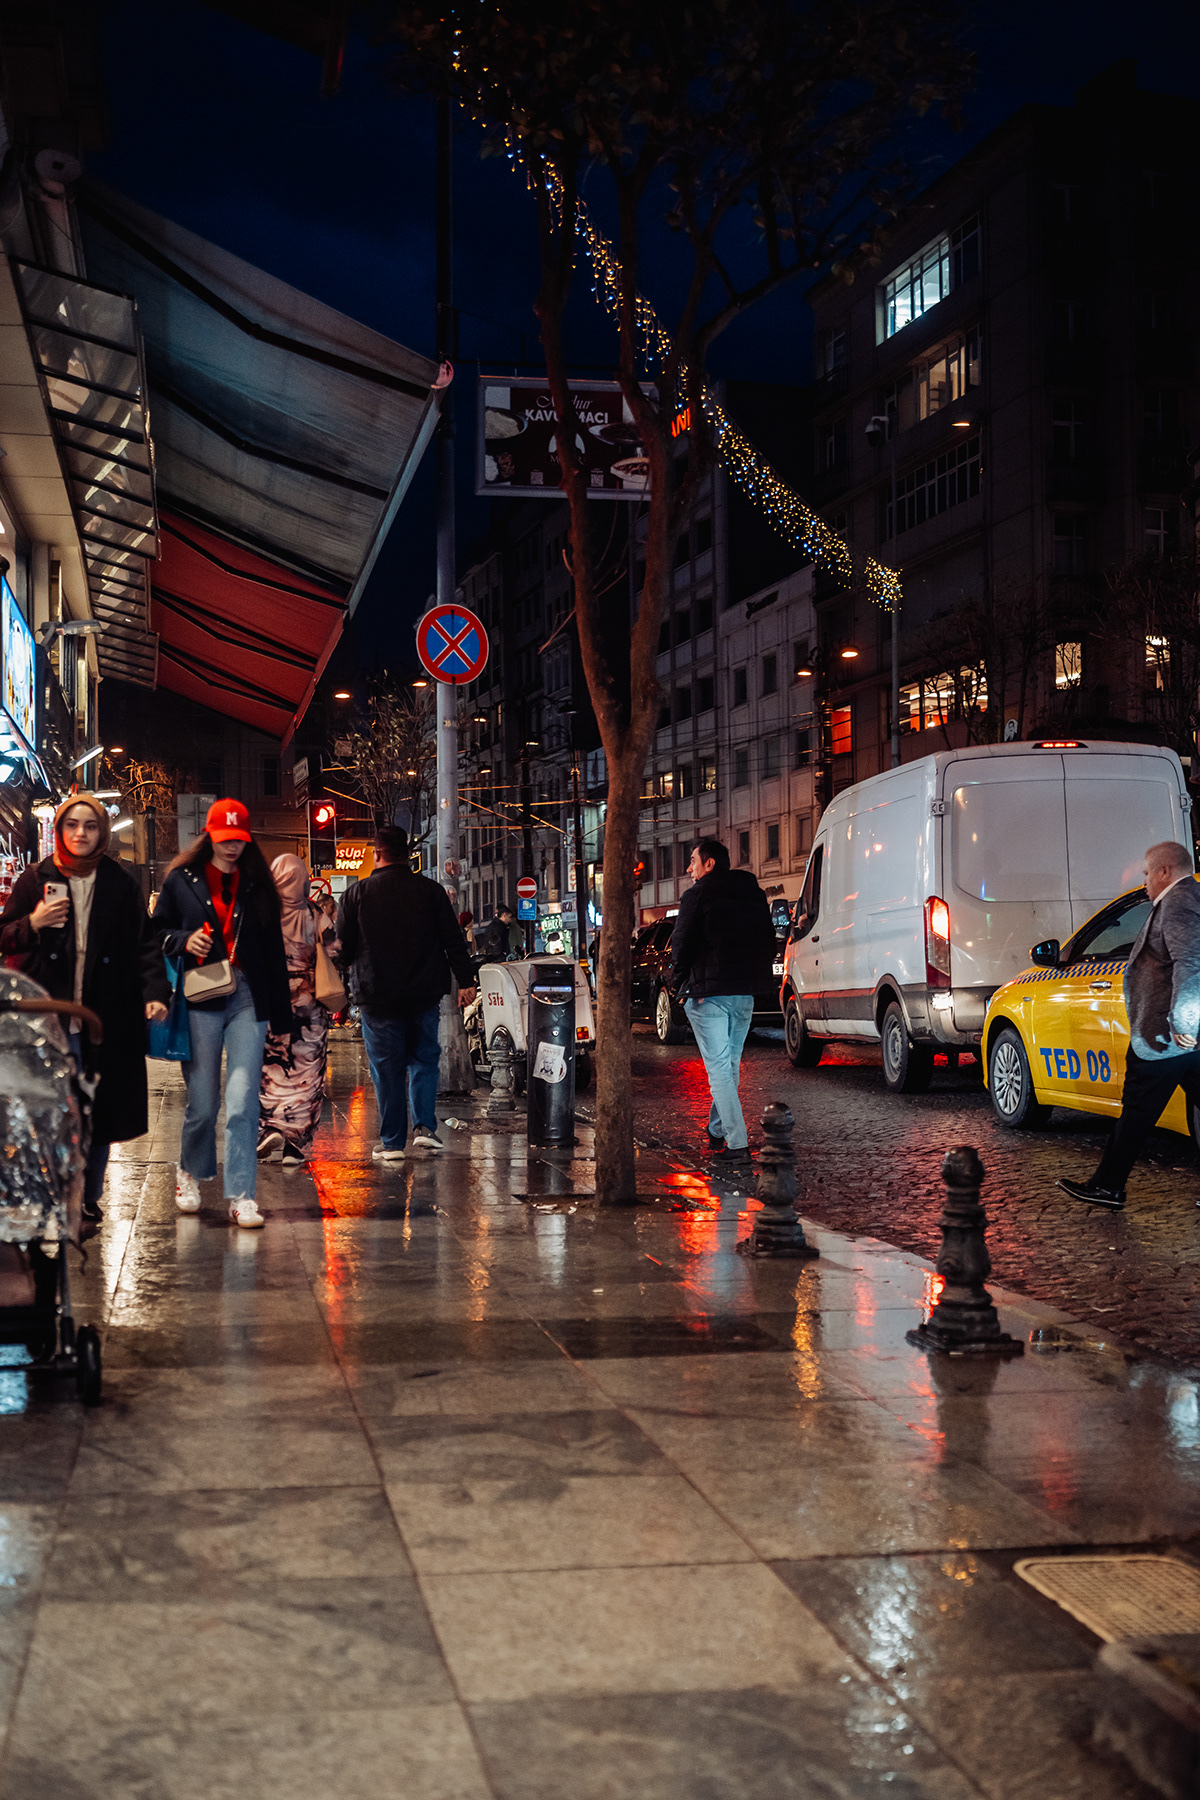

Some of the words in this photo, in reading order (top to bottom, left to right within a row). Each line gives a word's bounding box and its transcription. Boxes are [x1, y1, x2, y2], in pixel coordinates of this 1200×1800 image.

[225, 812, 239, 826] M
[1039, 1047, 1082, 1080] TED
[1086, 1049, 1112, 1083] 08
